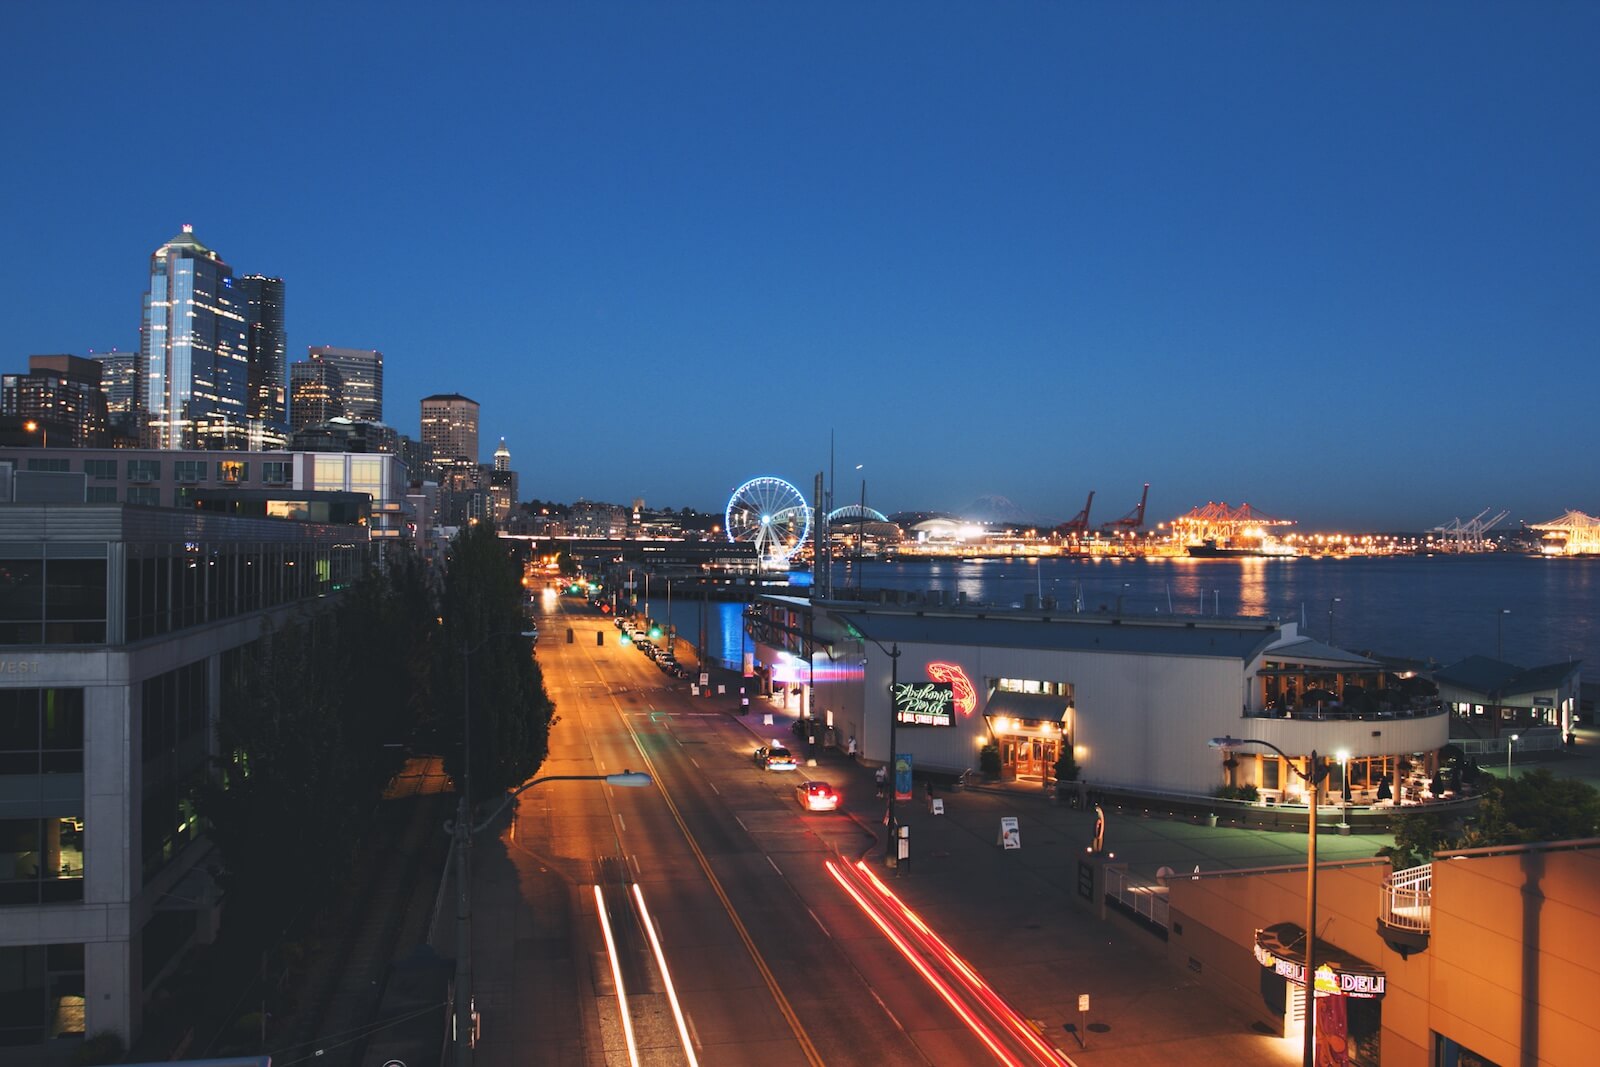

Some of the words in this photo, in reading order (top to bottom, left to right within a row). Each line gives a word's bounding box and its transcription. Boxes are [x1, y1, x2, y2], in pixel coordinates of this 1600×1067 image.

[896, 683, 953, 704] Anthony's
[898, 697, 929, 713] Pier
[929, 702, 947, 715] 66
[1341, 973, 1385, 993] DELI
